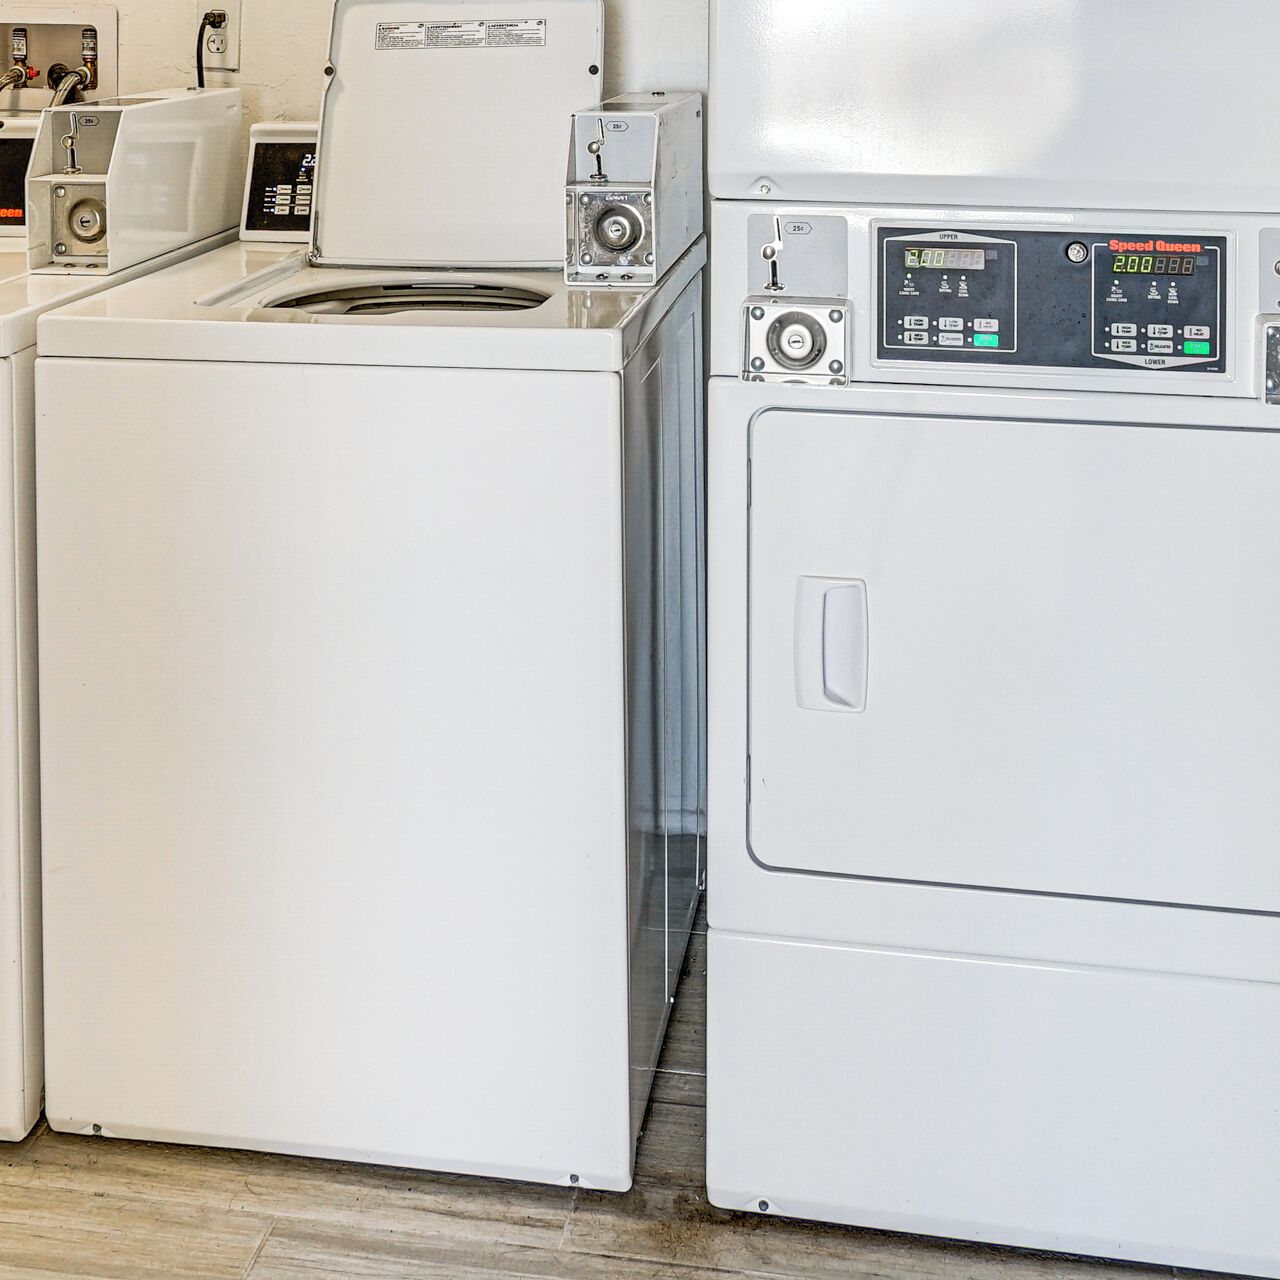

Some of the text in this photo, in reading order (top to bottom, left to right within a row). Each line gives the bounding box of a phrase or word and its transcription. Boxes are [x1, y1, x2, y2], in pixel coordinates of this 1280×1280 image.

[1109, 240, 1200, 252] Speed Queen
[1113, 256, 1152, 272] 2.00
